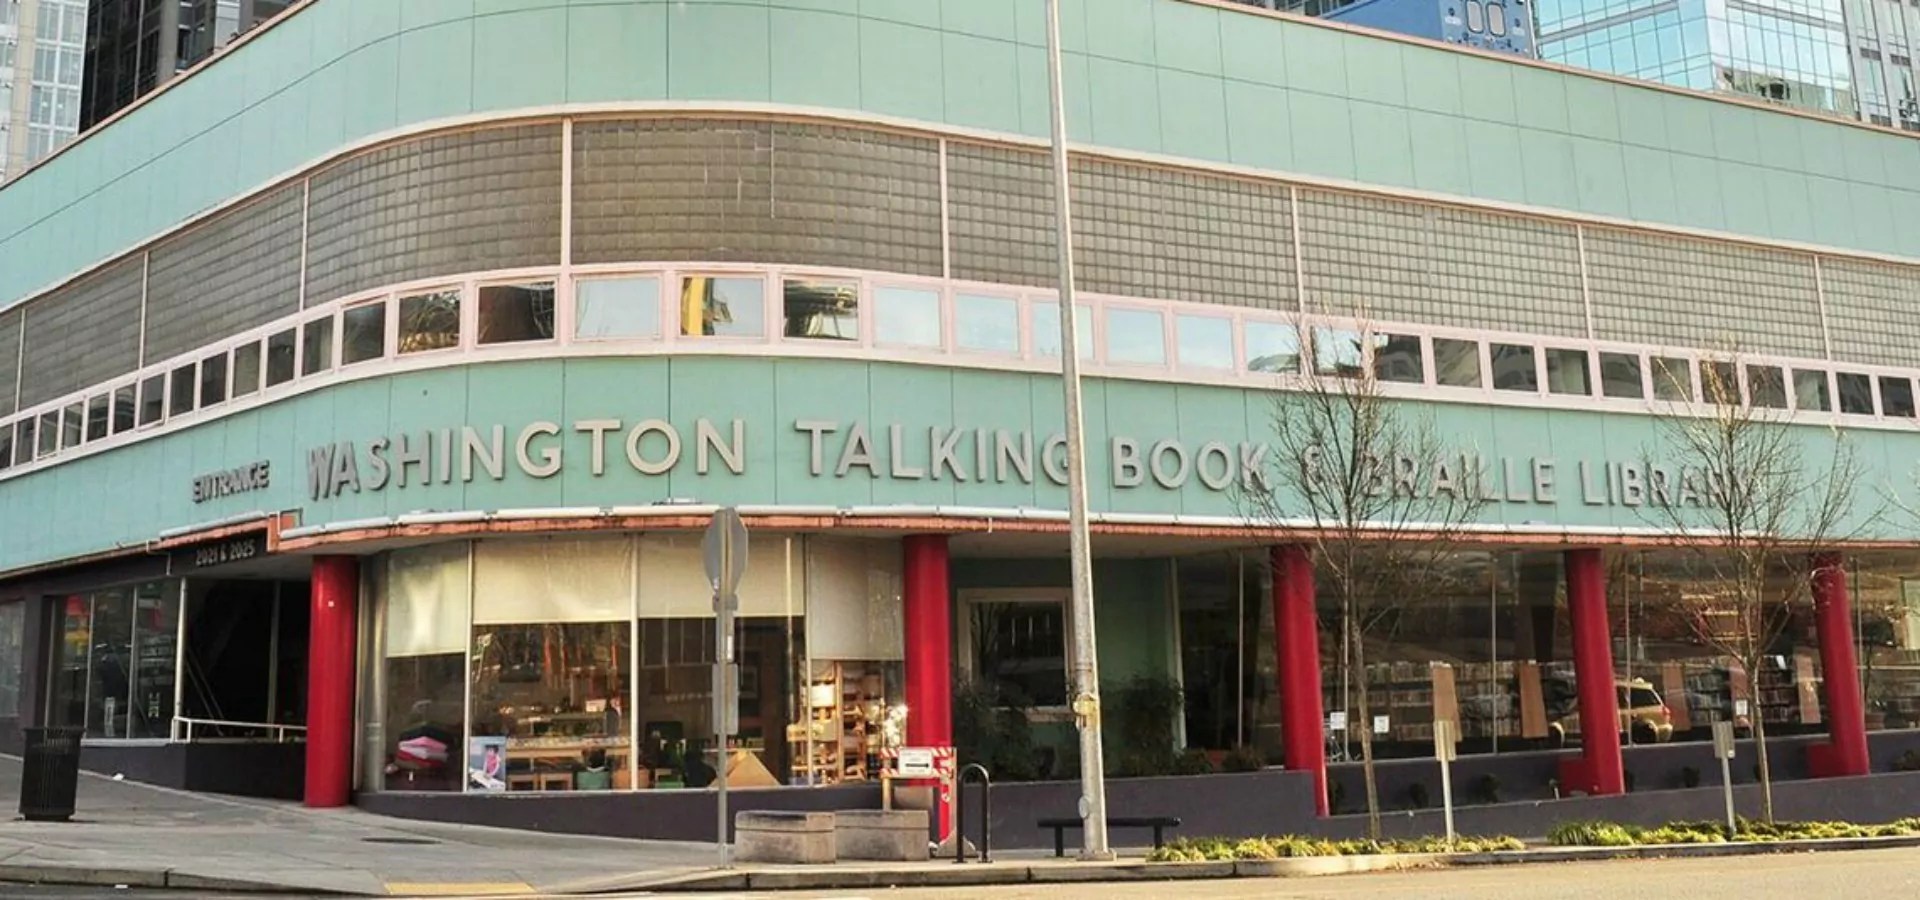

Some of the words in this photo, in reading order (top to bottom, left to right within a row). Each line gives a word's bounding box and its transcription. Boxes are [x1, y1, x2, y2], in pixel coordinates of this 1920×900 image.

[193, 460, 269, 503] ENTRANCE
[307, 419, 745, 500] WASHINGTON
[794, 420, 1070, 486] TALKING
[1111, 436, 1272, 492] BOOK
[1360, 449, 1556, 505] BRAILLE
